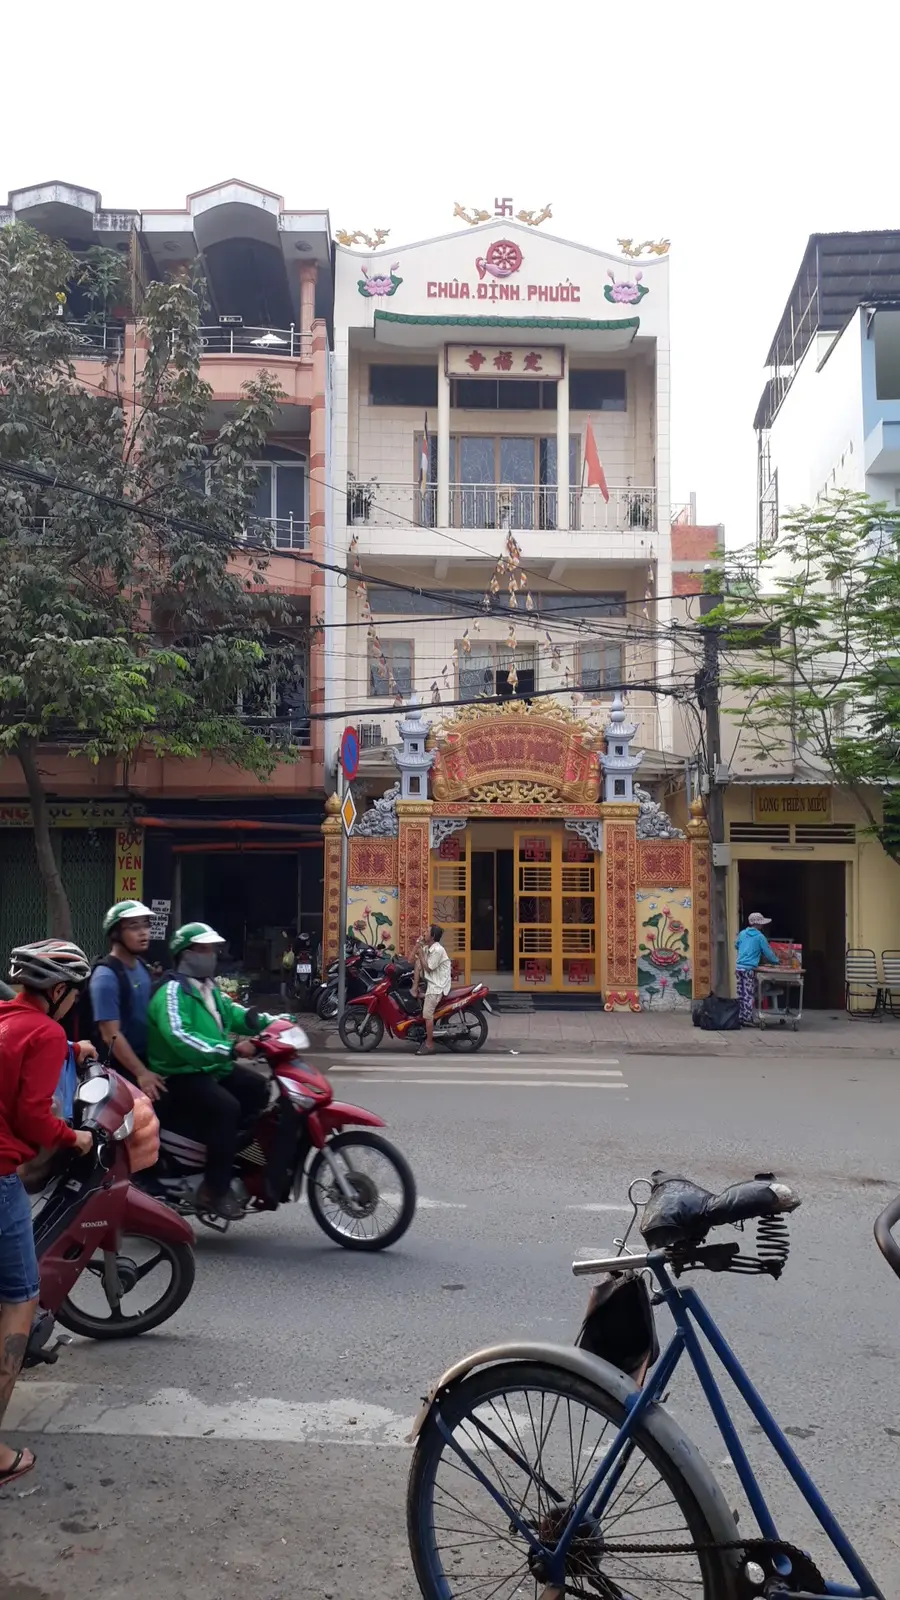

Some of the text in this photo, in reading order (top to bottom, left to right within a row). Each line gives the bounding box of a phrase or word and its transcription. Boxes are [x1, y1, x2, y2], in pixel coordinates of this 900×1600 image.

[477, 280, 520, 303] ĐỊNH
[527, 278, 581, 302] PHƯỚC
[118, 852, 142, 870] YÊN
[122, 877, 137, 892] XE
[81, 1220, 108, 1228] HONDA
